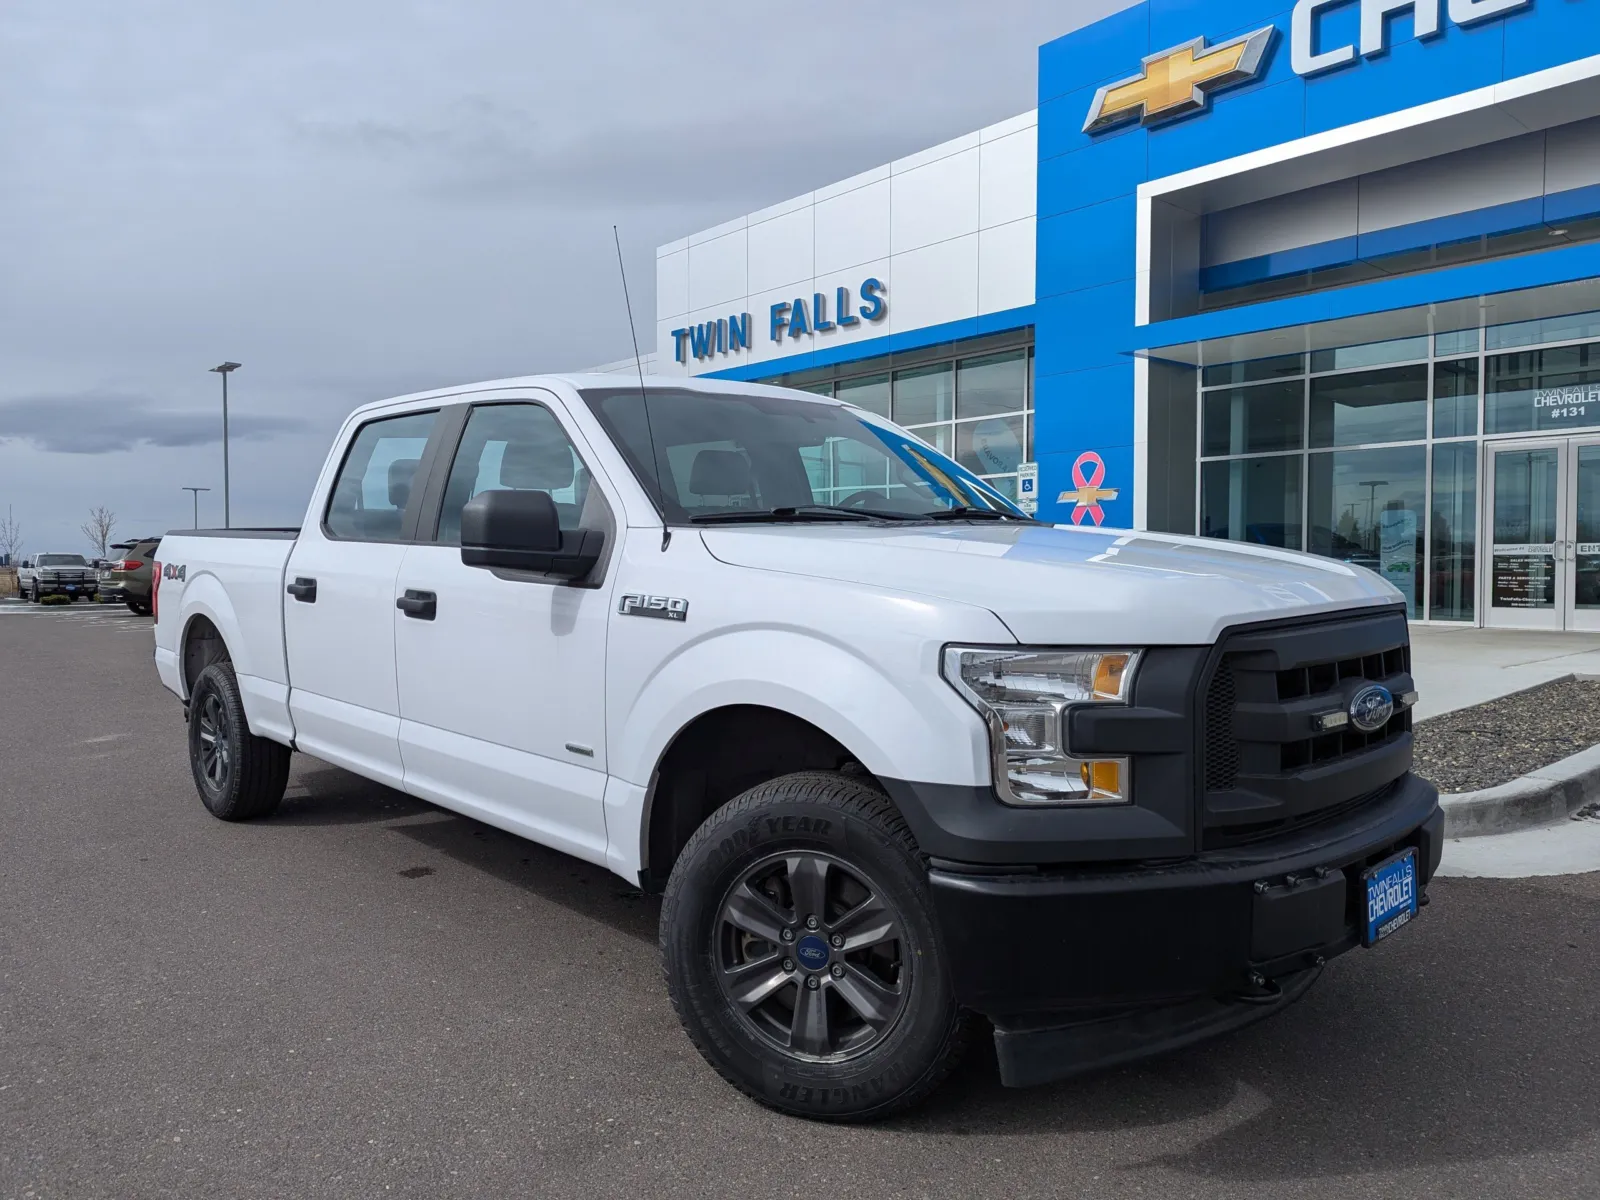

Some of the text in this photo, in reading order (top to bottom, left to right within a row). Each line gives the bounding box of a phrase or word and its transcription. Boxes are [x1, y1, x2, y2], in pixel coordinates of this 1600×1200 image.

[671, 277, 887, 363] TWIN FALLS
[1551, 406, 1585, 418] #131
[1368, 877, 1413, 923] CHEVROLET
